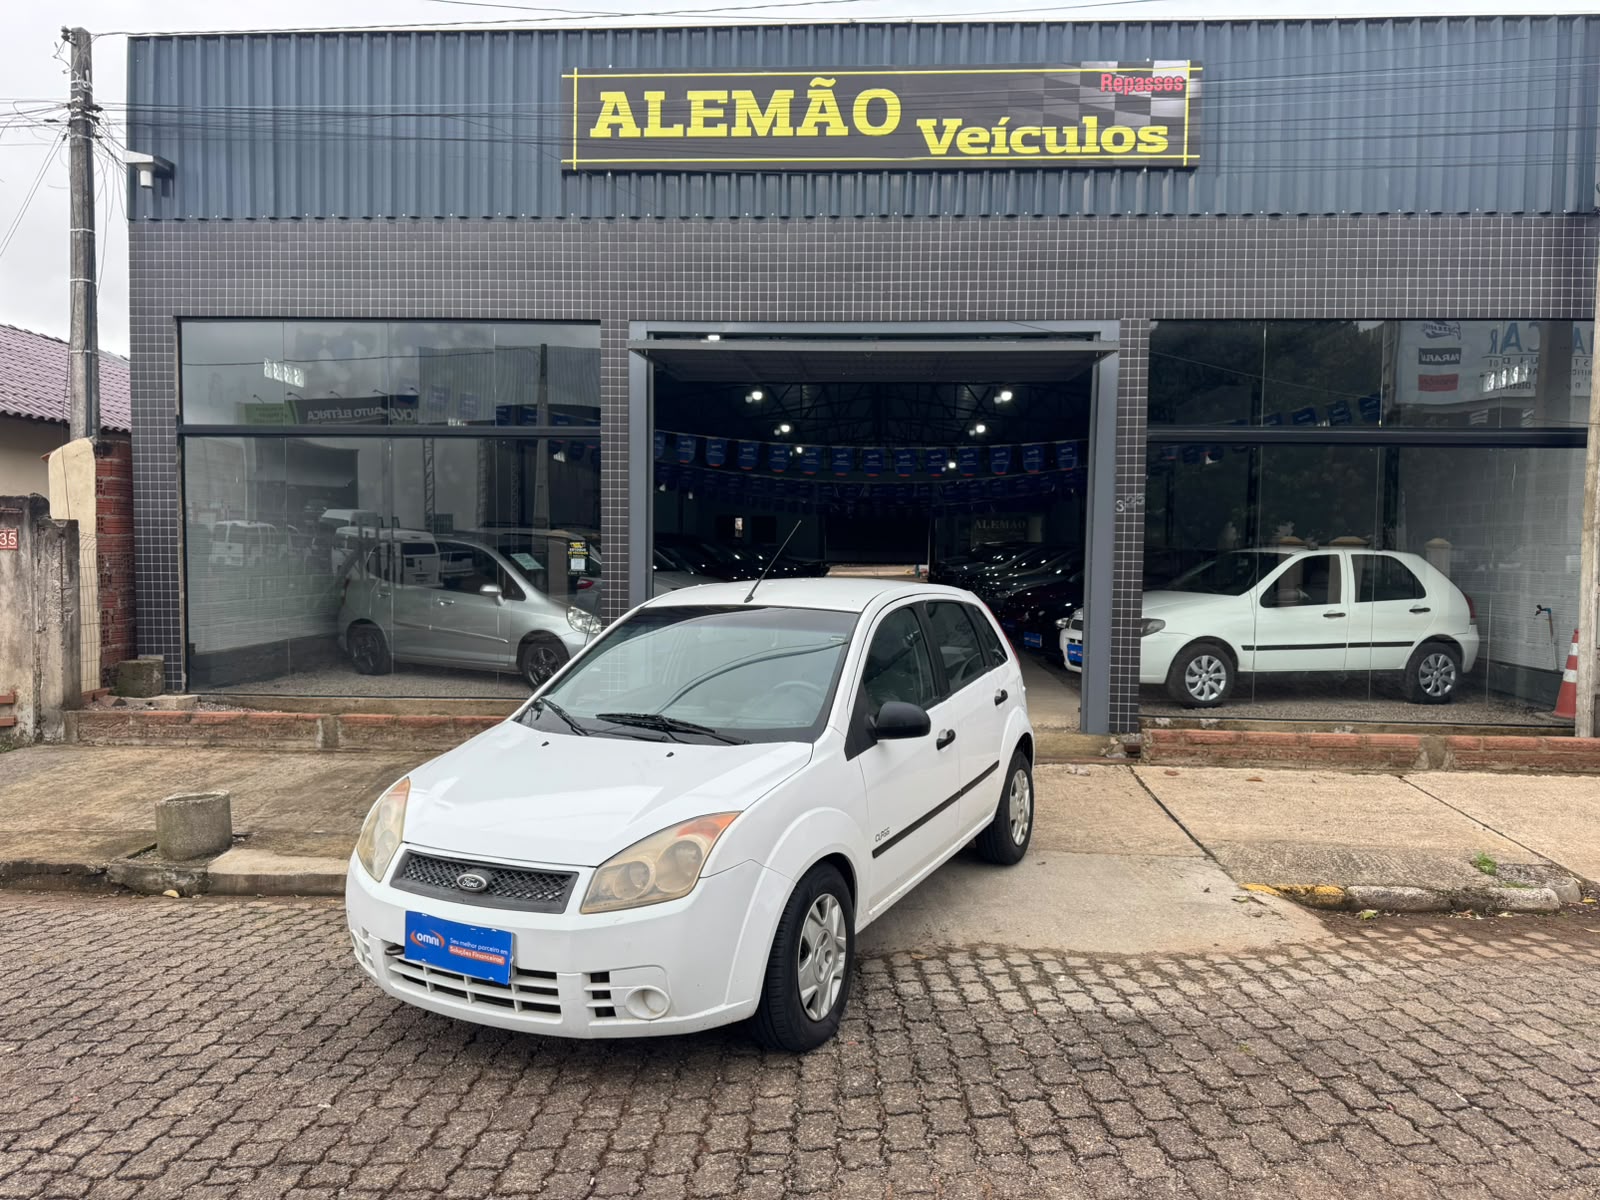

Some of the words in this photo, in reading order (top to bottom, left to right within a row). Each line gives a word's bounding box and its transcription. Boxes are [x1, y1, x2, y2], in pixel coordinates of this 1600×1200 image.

[1100, 73, 1184, 95] Repasses
[589, 76, 902, 138] ALEMÃO
[916, 115, 1169, 156] Veículos
[416, 932, 440, 947] omni
[449, 937, 460, 945] Seu
[459, 940, 477, 949] melhor
[477, 944, 500, 953] parceiro
[449, 945, 472, 957] Soluções
